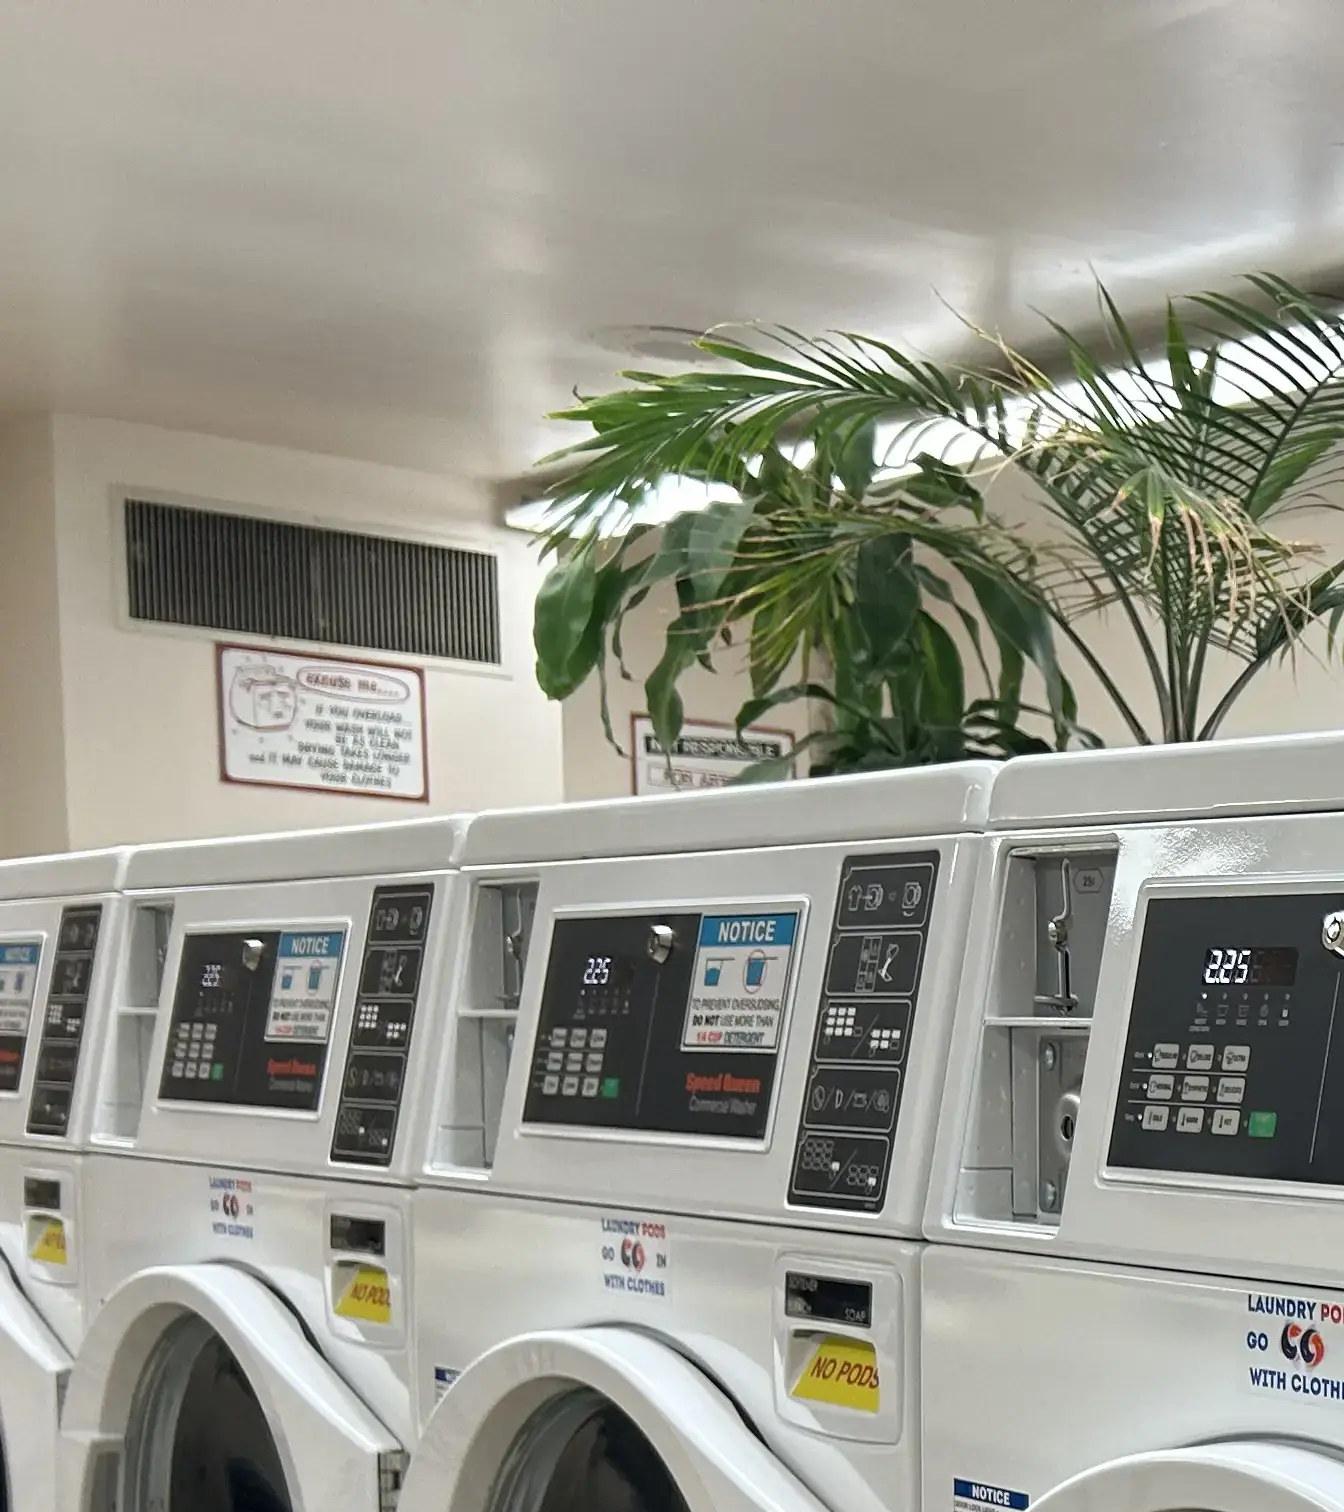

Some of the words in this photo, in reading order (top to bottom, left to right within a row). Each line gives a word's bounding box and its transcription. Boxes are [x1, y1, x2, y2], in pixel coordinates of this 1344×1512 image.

[718, 920, 776, 943] NOTICE
[292, 936, 330, 955] NOTICE
[1205, 949, 1251, 984] 2.25
[692, 1014, 703, 1027] DO
[704, 1014, 720, 1027] NOT
[735, 1015, 754, 1027] MORE
[756, 1015, 774, 1028] THAN
[603, 1272, 625, 1289] WITH
[627, 1276, 665, 1296] CLOTHES
[1248, 1293, 1316, 1320] LAUNDRY
[1247, 1331, 1268, 1351] GO
[810, 1356, 837, 1379] NO
[836, 1360, 880, 1389] PODS
[1249, 1367, 1286, 1390] WITH
[972, 1484, 1011, 1505] NOTICE
